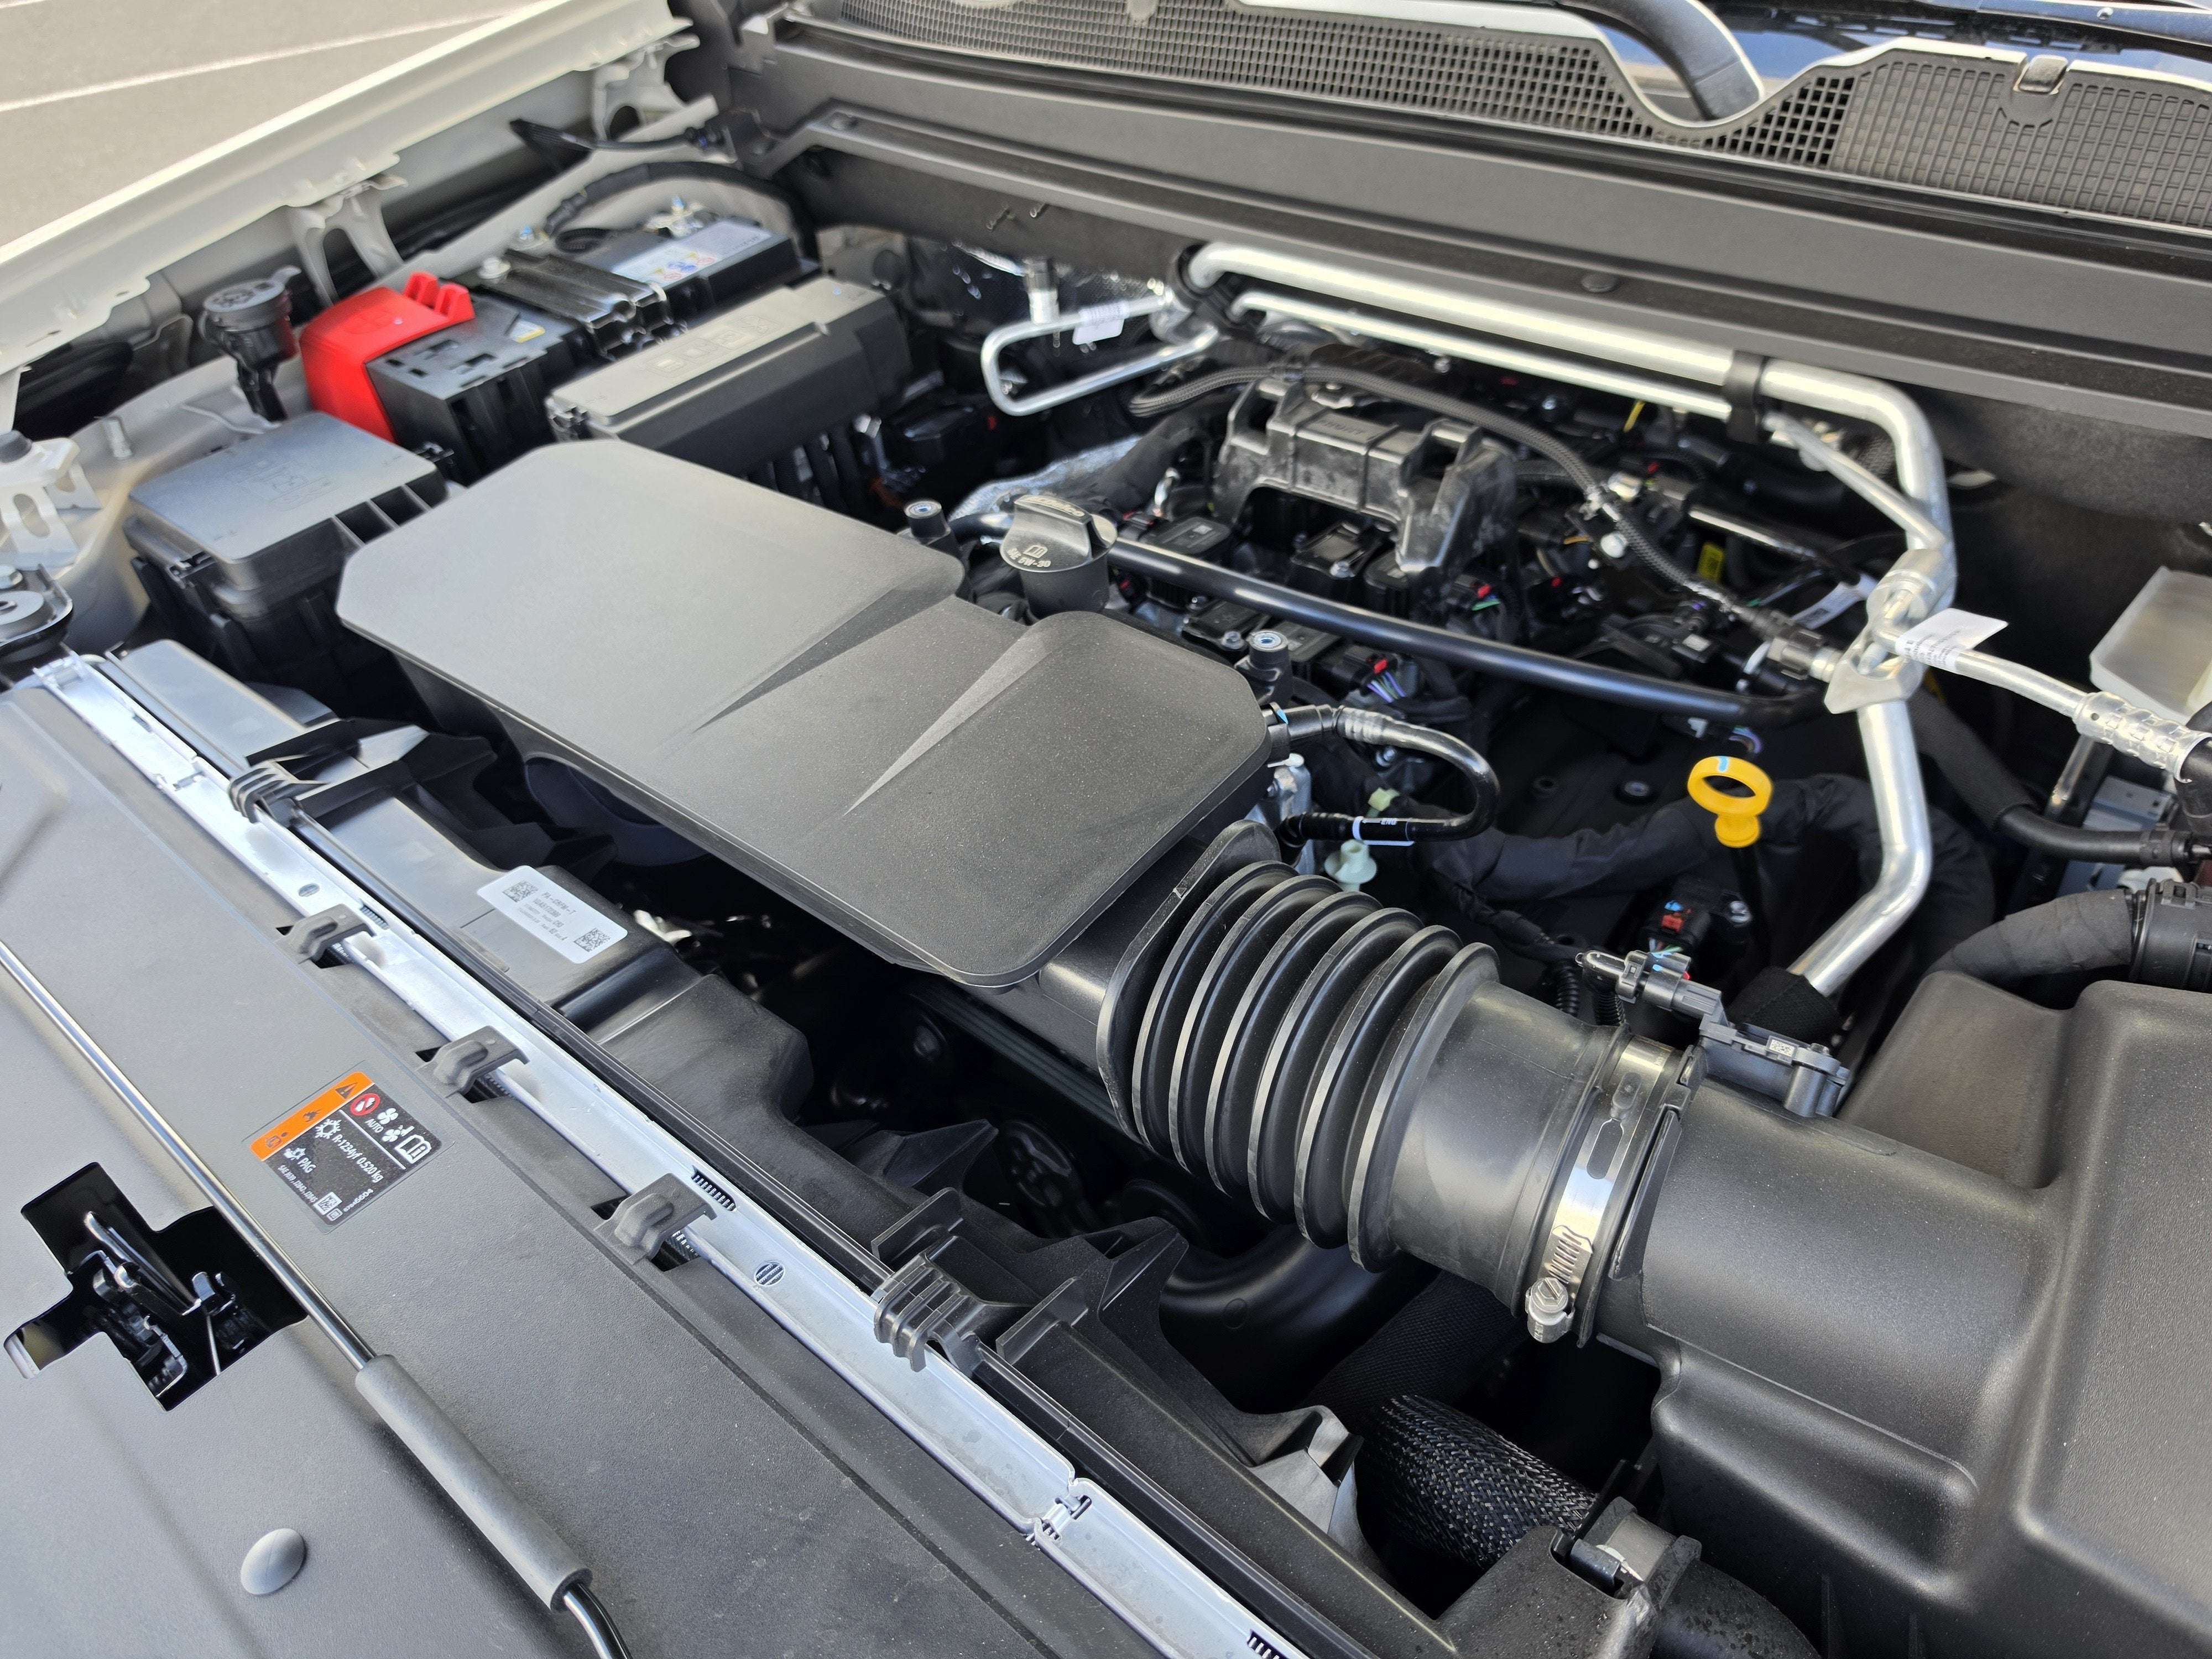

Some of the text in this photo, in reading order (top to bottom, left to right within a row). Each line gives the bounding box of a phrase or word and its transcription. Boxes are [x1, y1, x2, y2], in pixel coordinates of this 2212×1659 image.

[1006, 548, 1051, 567] SAE 5W-30
[365, 1118, 384, 1133] AUTO
[297, 1157, 316, 1173] PAG
[332, 1134, 363, 1160] R-1234yf
[371, 1170, 384, 1183] kg
[278, 1165, 289, 1174] SAE
